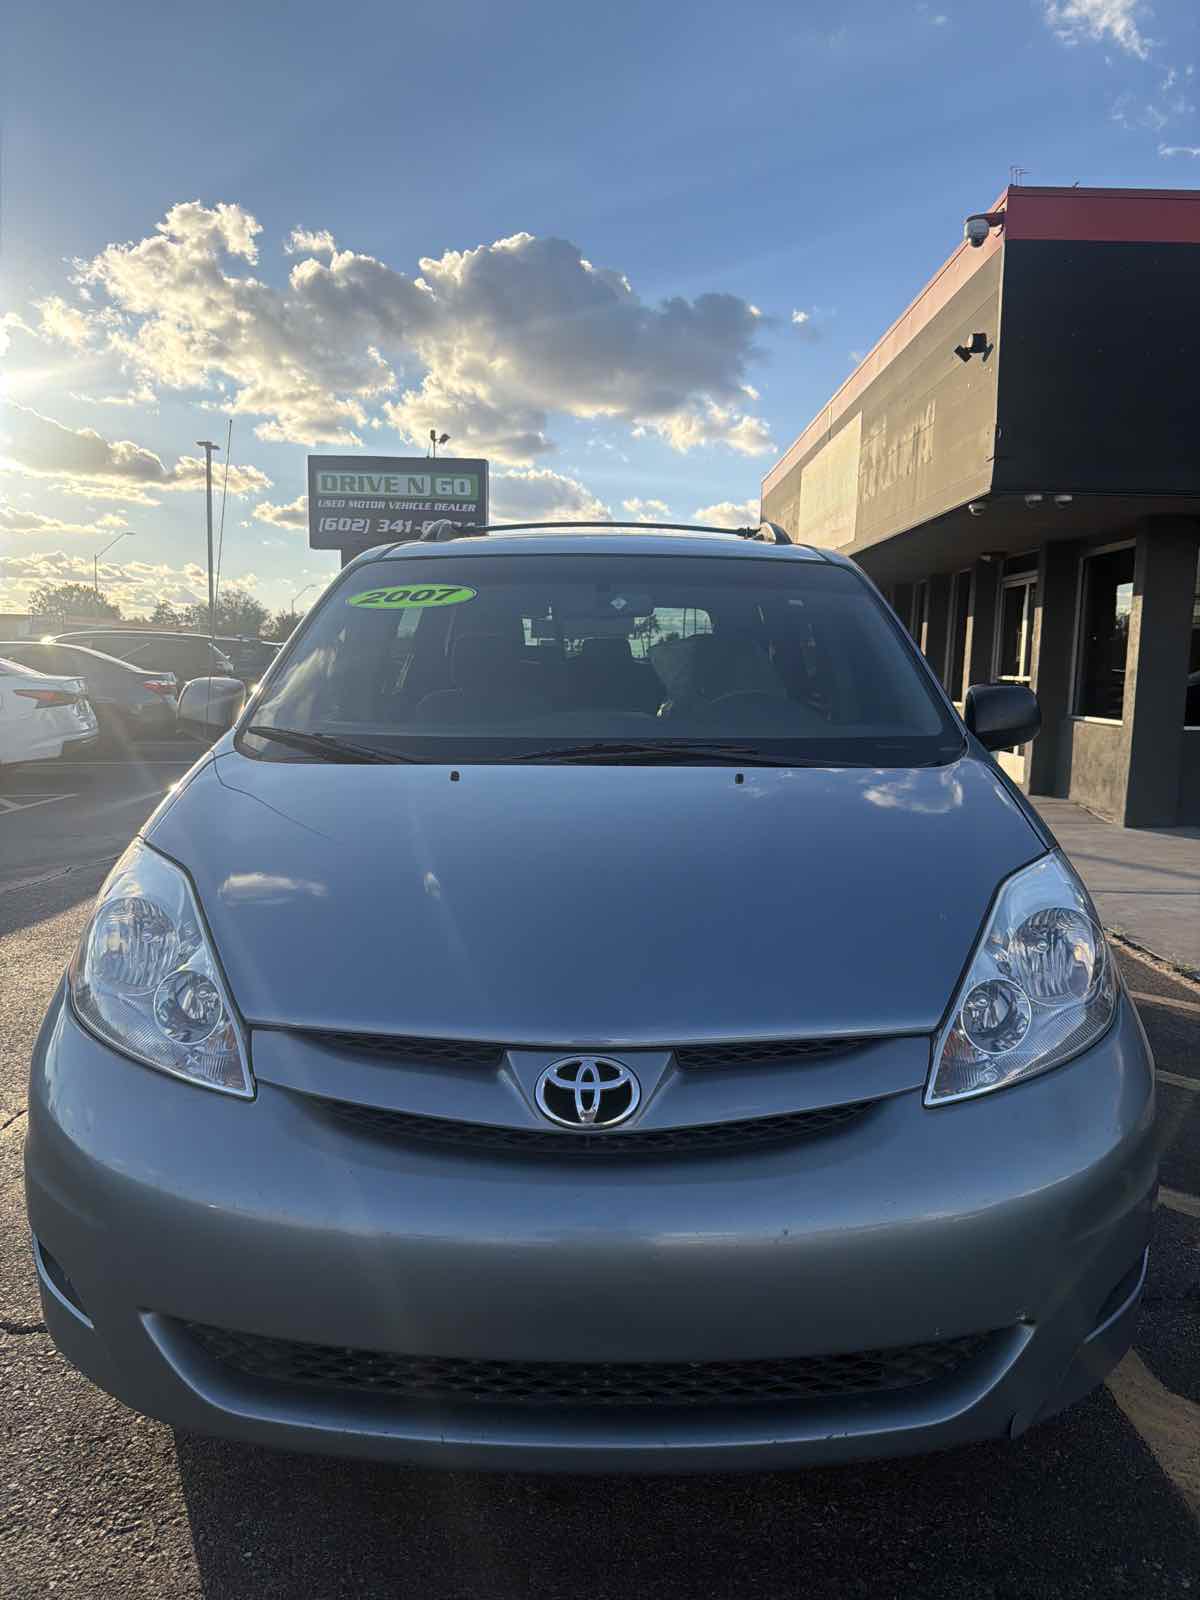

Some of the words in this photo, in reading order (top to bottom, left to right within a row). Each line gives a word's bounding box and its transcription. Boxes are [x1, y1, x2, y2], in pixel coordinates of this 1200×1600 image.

[320, 474, 399, 494] DRIVE
[407, 476, 425, 494] N
[435, 477, 472, 496] GO
[317, 499, 345, 508] USED
[348, 500, 387, 510] MOTOR
[389, 501, 433, 511] VEHICLE
[434, 502, 477, 512] DEALER
[318, 516, 371, 534] (602)
[356, 588, 462, 604] 2007
